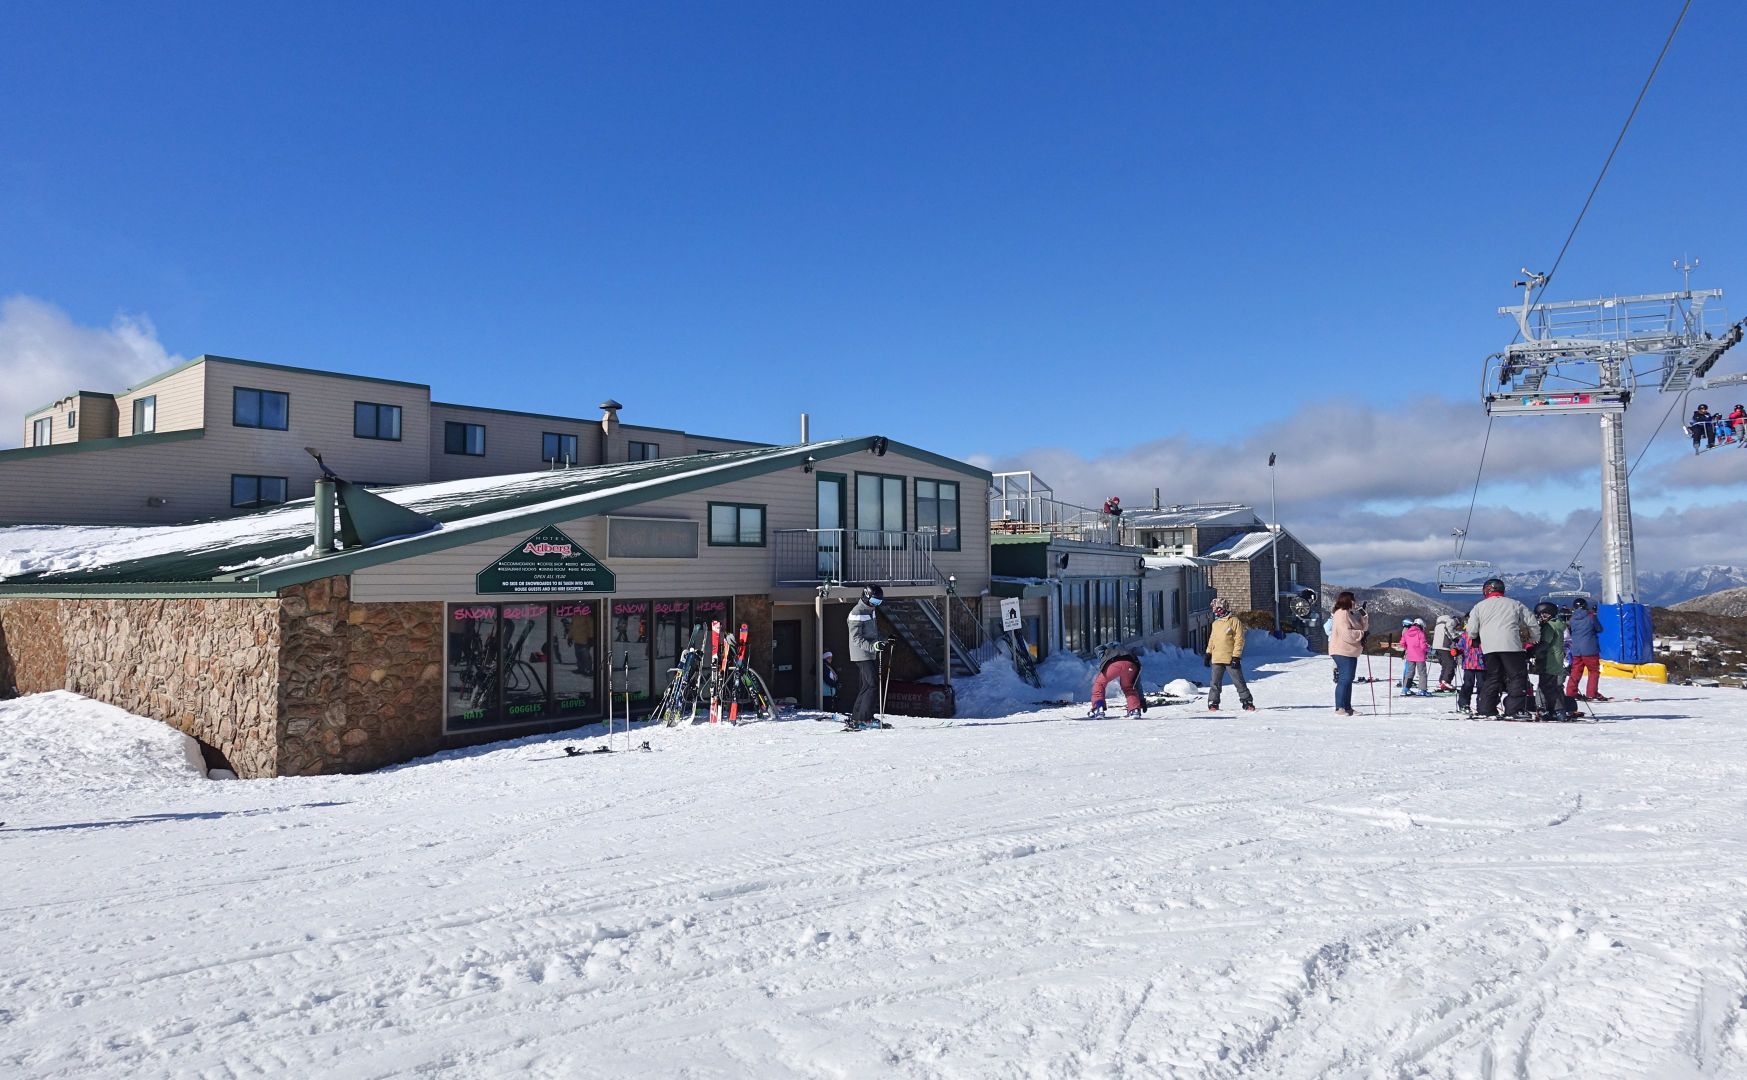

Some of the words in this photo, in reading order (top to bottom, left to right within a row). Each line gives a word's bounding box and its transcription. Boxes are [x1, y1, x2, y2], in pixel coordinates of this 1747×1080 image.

[523, 542, 572, 556] Arlberg
[454, 607, 495, 620] SNOW
[614, 603, 647, 614] SNOW
[509, 704, 542, 714] GOGGLES
[561, 699, 586, 709] GLOVES
[463, 711, 484, 720] HATS
